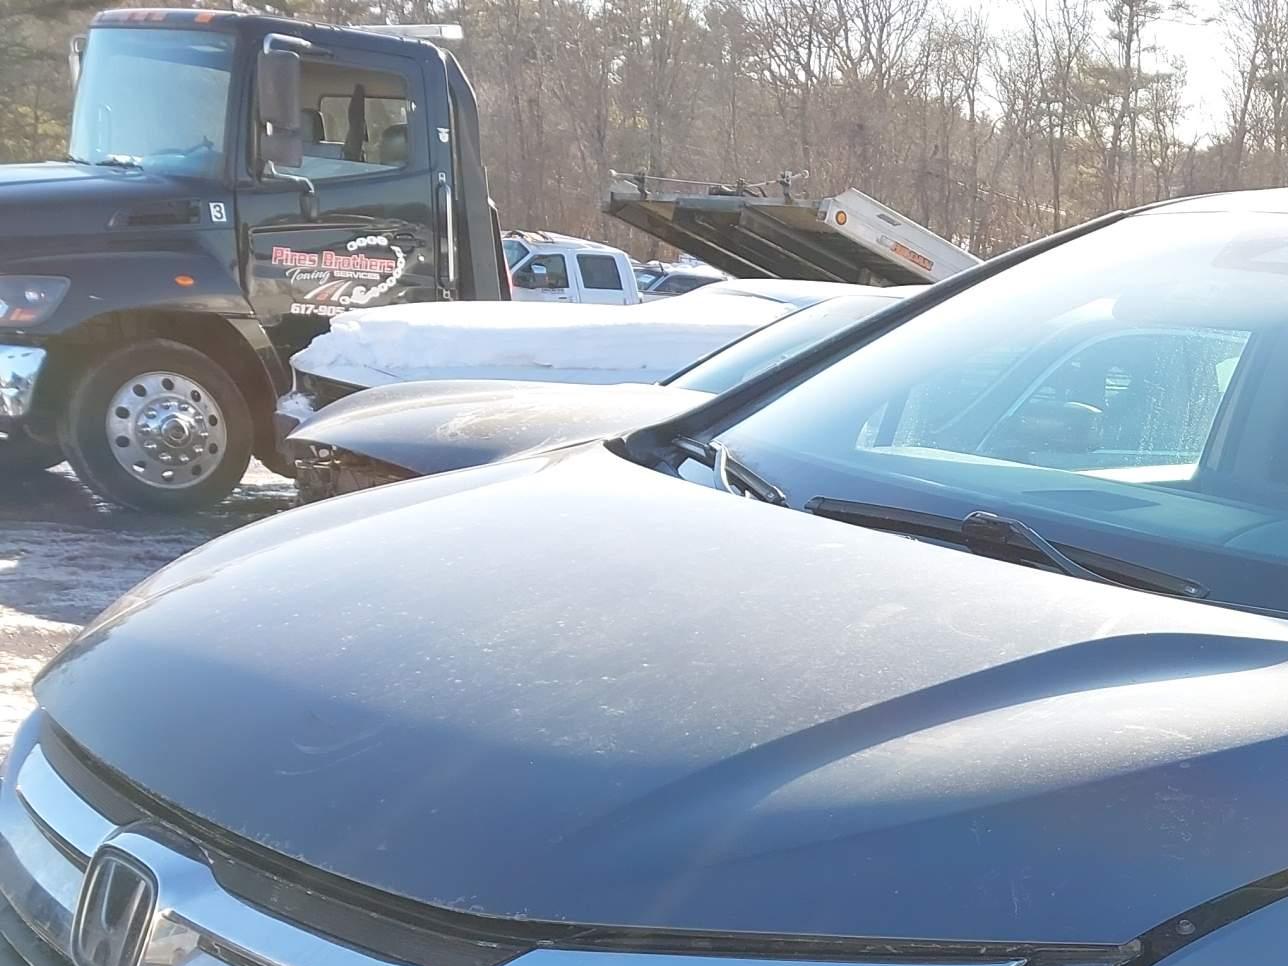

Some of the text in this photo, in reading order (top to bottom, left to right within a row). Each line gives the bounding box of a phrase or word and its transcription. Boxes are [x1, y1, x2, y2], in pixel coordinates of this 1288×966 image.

[213, 205, 224, 219] 3
[272, 246, 396, 273] Pires Brothers
[286, 267, 380, 284] Towing SERVICES
